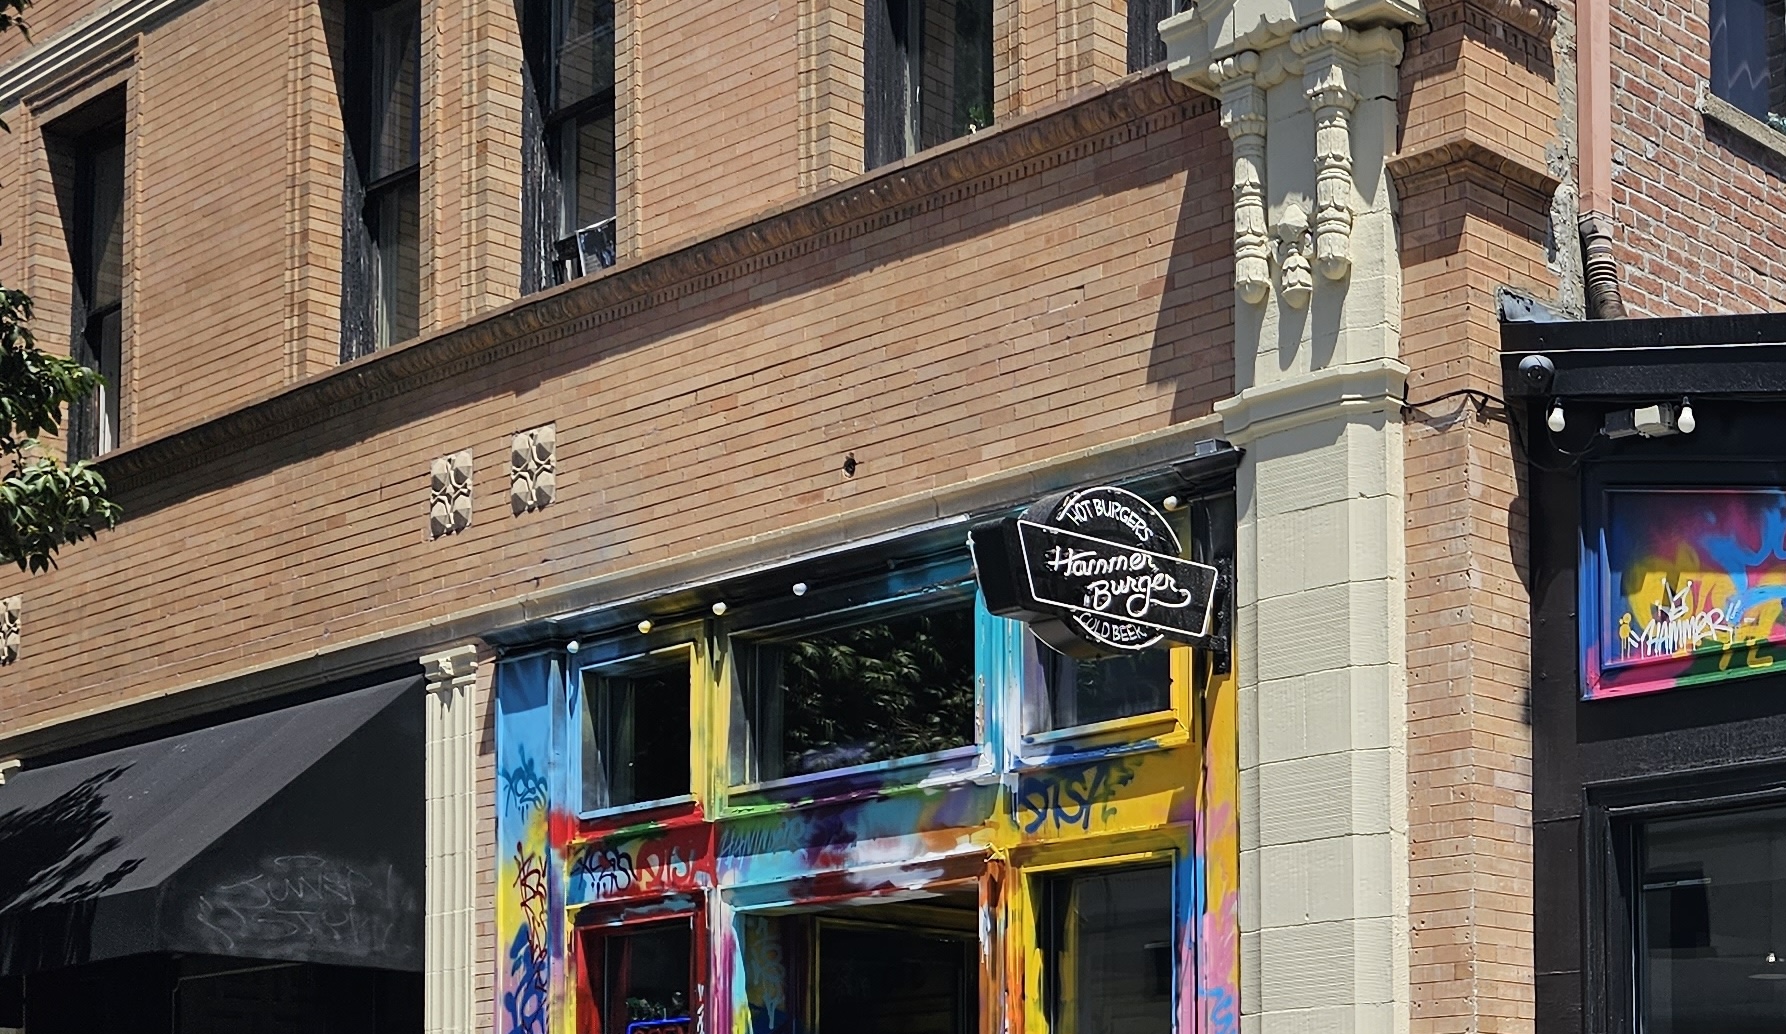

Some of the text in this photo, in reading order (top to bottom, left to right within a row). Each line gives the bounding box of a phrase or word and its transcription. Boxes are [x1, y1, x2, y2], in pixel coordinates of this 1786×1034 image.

[1066, 498, 1154, 542] HOT BURGERS
[1046, 545, 1159, 577] Hammer
[1083, 571, 1191, 617] Burger
[1077, 612, 1110, 638] COLD
